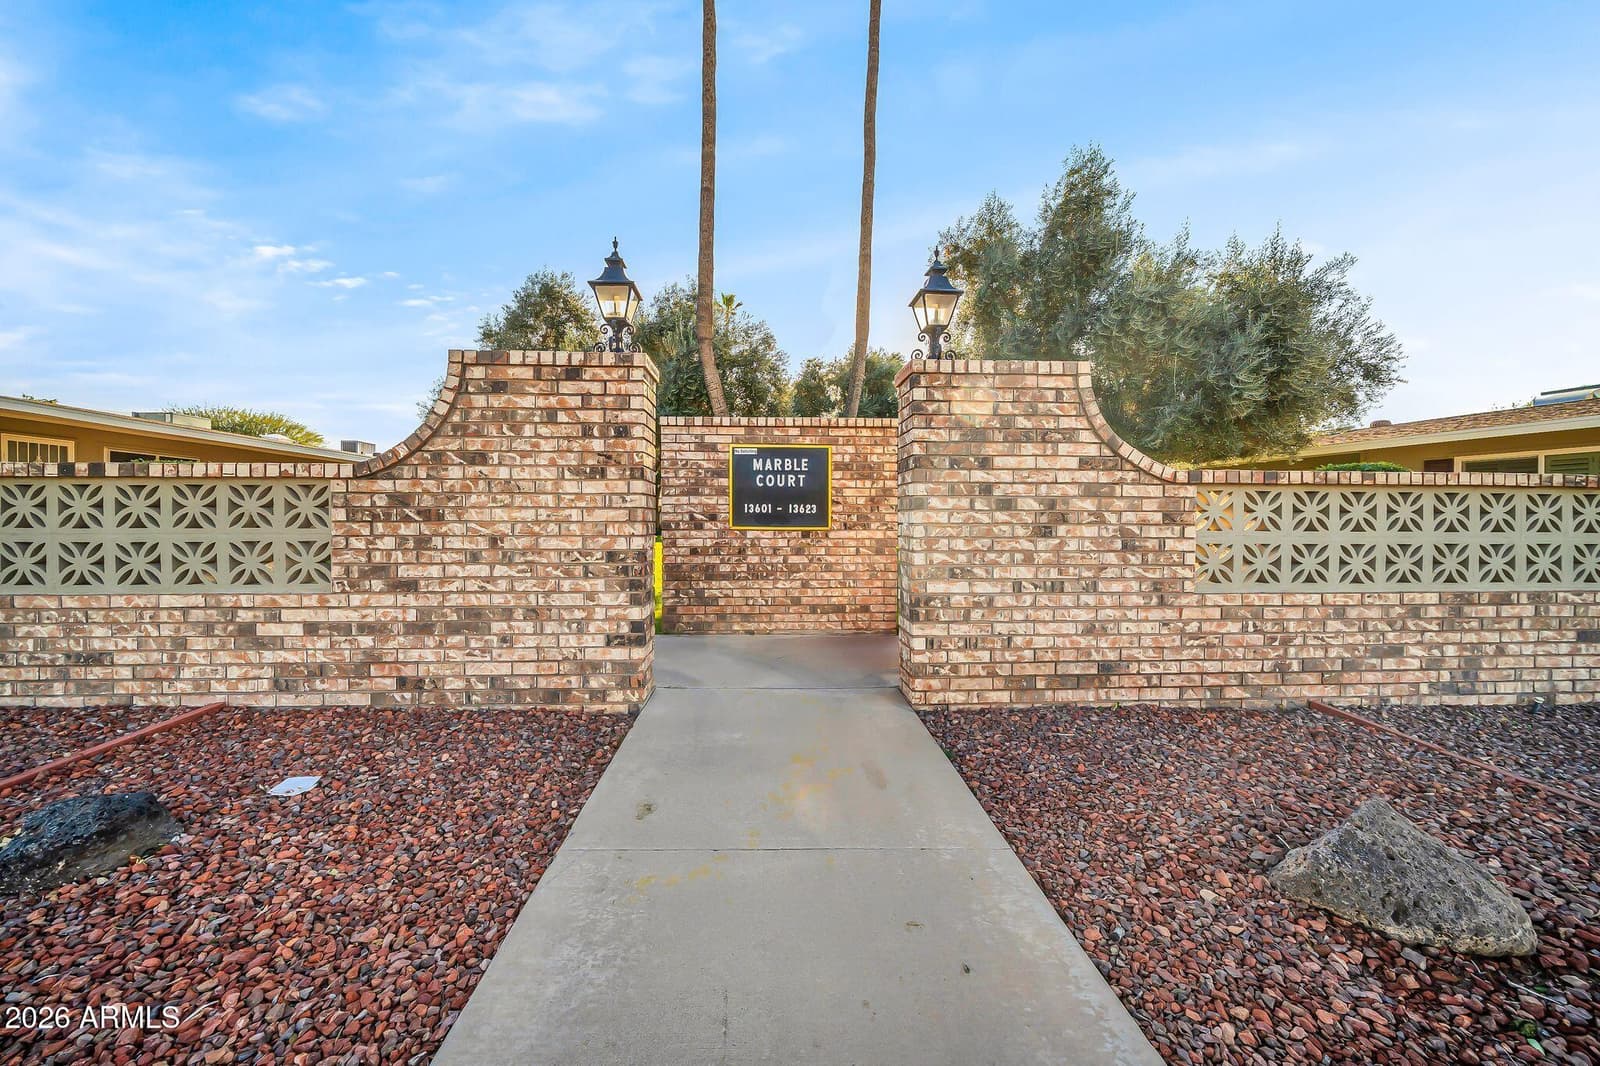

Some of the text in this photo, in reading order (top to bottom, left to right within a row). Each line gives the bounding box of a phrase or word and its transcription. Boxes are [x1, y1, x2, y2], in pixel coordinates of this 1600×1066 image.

[753, 458, 809, 471] MARBLE
[756, 474, 806, 487] COURT
[744, 503, 772, 514] 13601
[788, 503, 817, 514] 13623
